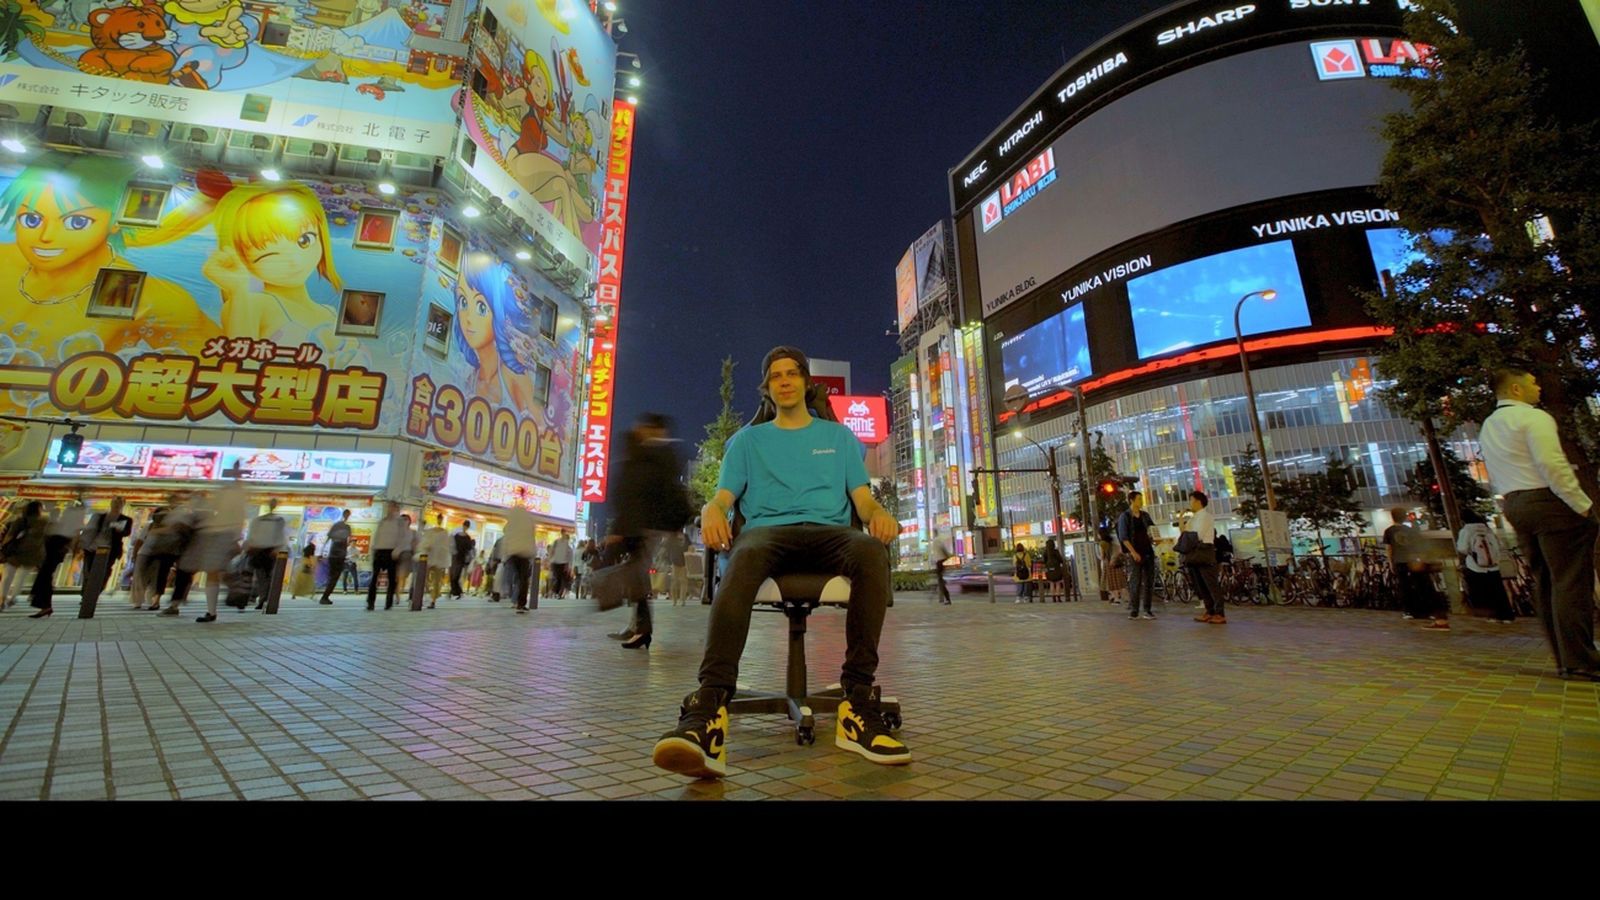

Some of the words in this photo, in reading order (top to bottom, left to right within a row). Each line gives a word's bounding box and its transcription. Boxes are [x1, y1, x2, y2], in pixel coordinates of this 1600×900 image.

[1156, 4, 1256, 46] SHARP
[16, 82, 60, 96] 株式会社
[70, 83, 191, 112] キタック販売
[1057, 51, 1128, 103] TOSHIBA
[361, 122, 431, 144] 北電子
[610, 108, 631, 175] パチンコ
[999, 110, 1043, 157] HITACHI
[963, 160, 988, 188] NEC
[1000, 147, 1055, 208] LABI
[601, 178, 625, 279] エスパス
[1251, 213, 1331, 238] YUNIKA
[1331, 208, 1400, 226] VISION
[1061, 275, 1103, 304] YUNIKA
[1103, 254, 1152, 283] VISION
[202, 337, 322, 363] メガホール
[590, 352, 611, 417] パチンコ
[843, 417, 876, 432] GAME
[584, 424, 606, 497] エスパス
